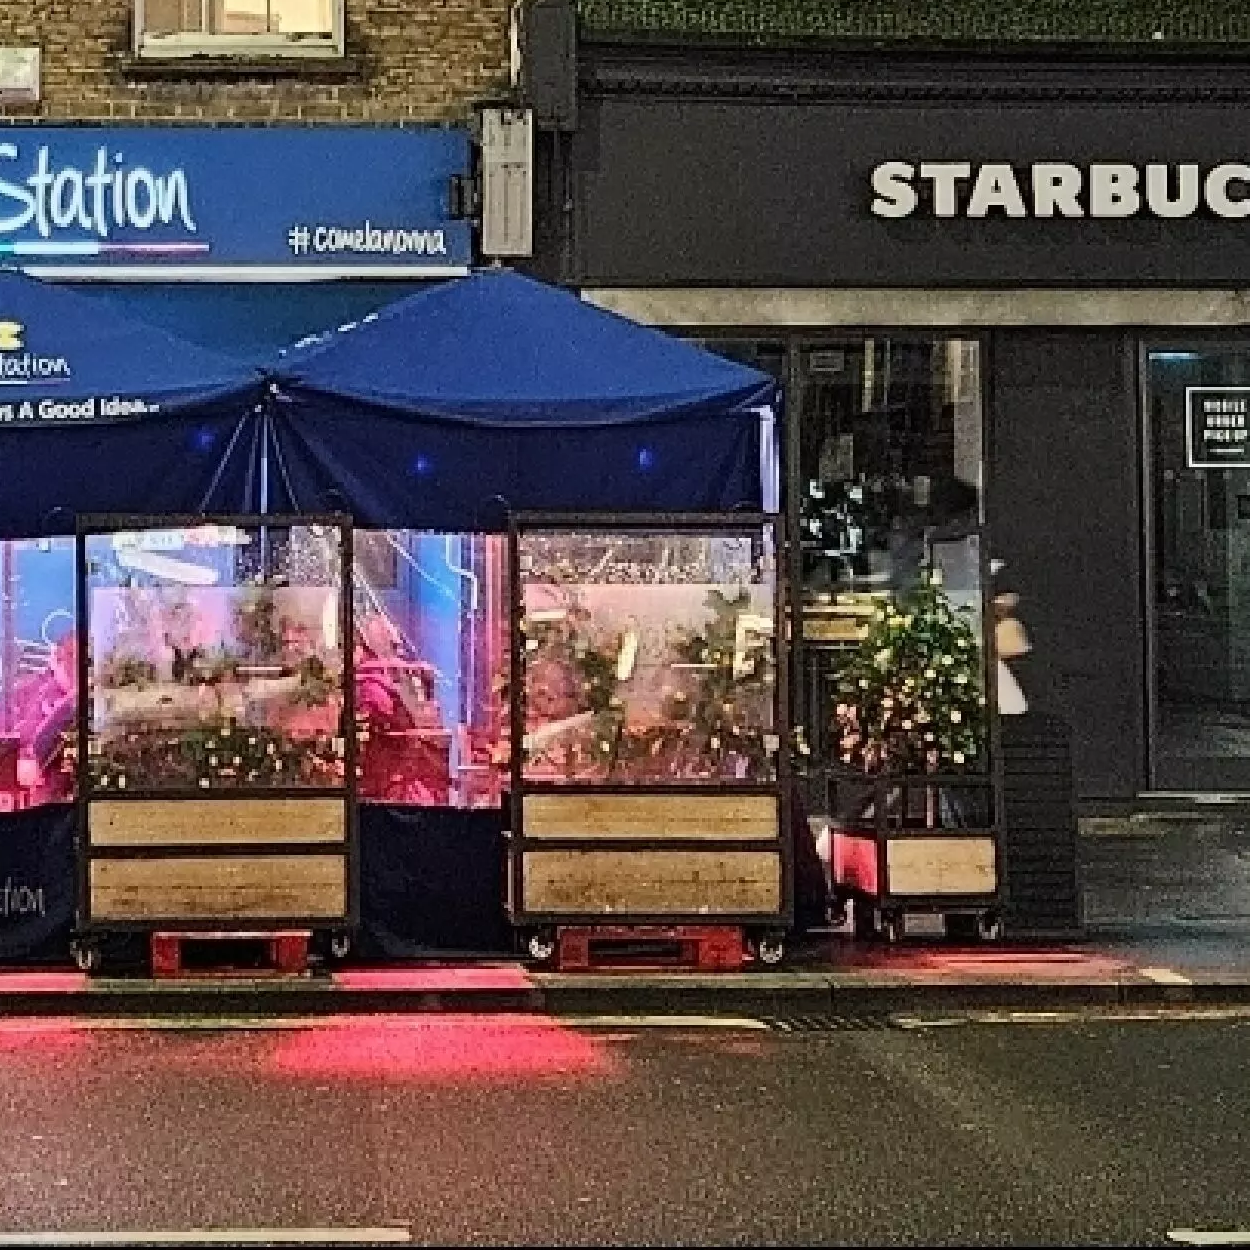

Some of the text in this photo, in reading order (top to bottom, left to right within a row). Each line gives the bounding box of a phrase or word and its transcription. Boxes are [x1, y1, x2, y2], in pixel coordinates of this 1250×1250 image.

[870, 161, 1250, 218] STARBUC
[19, 400, 34, 420] A
[39, 399, 95, 420] Good
